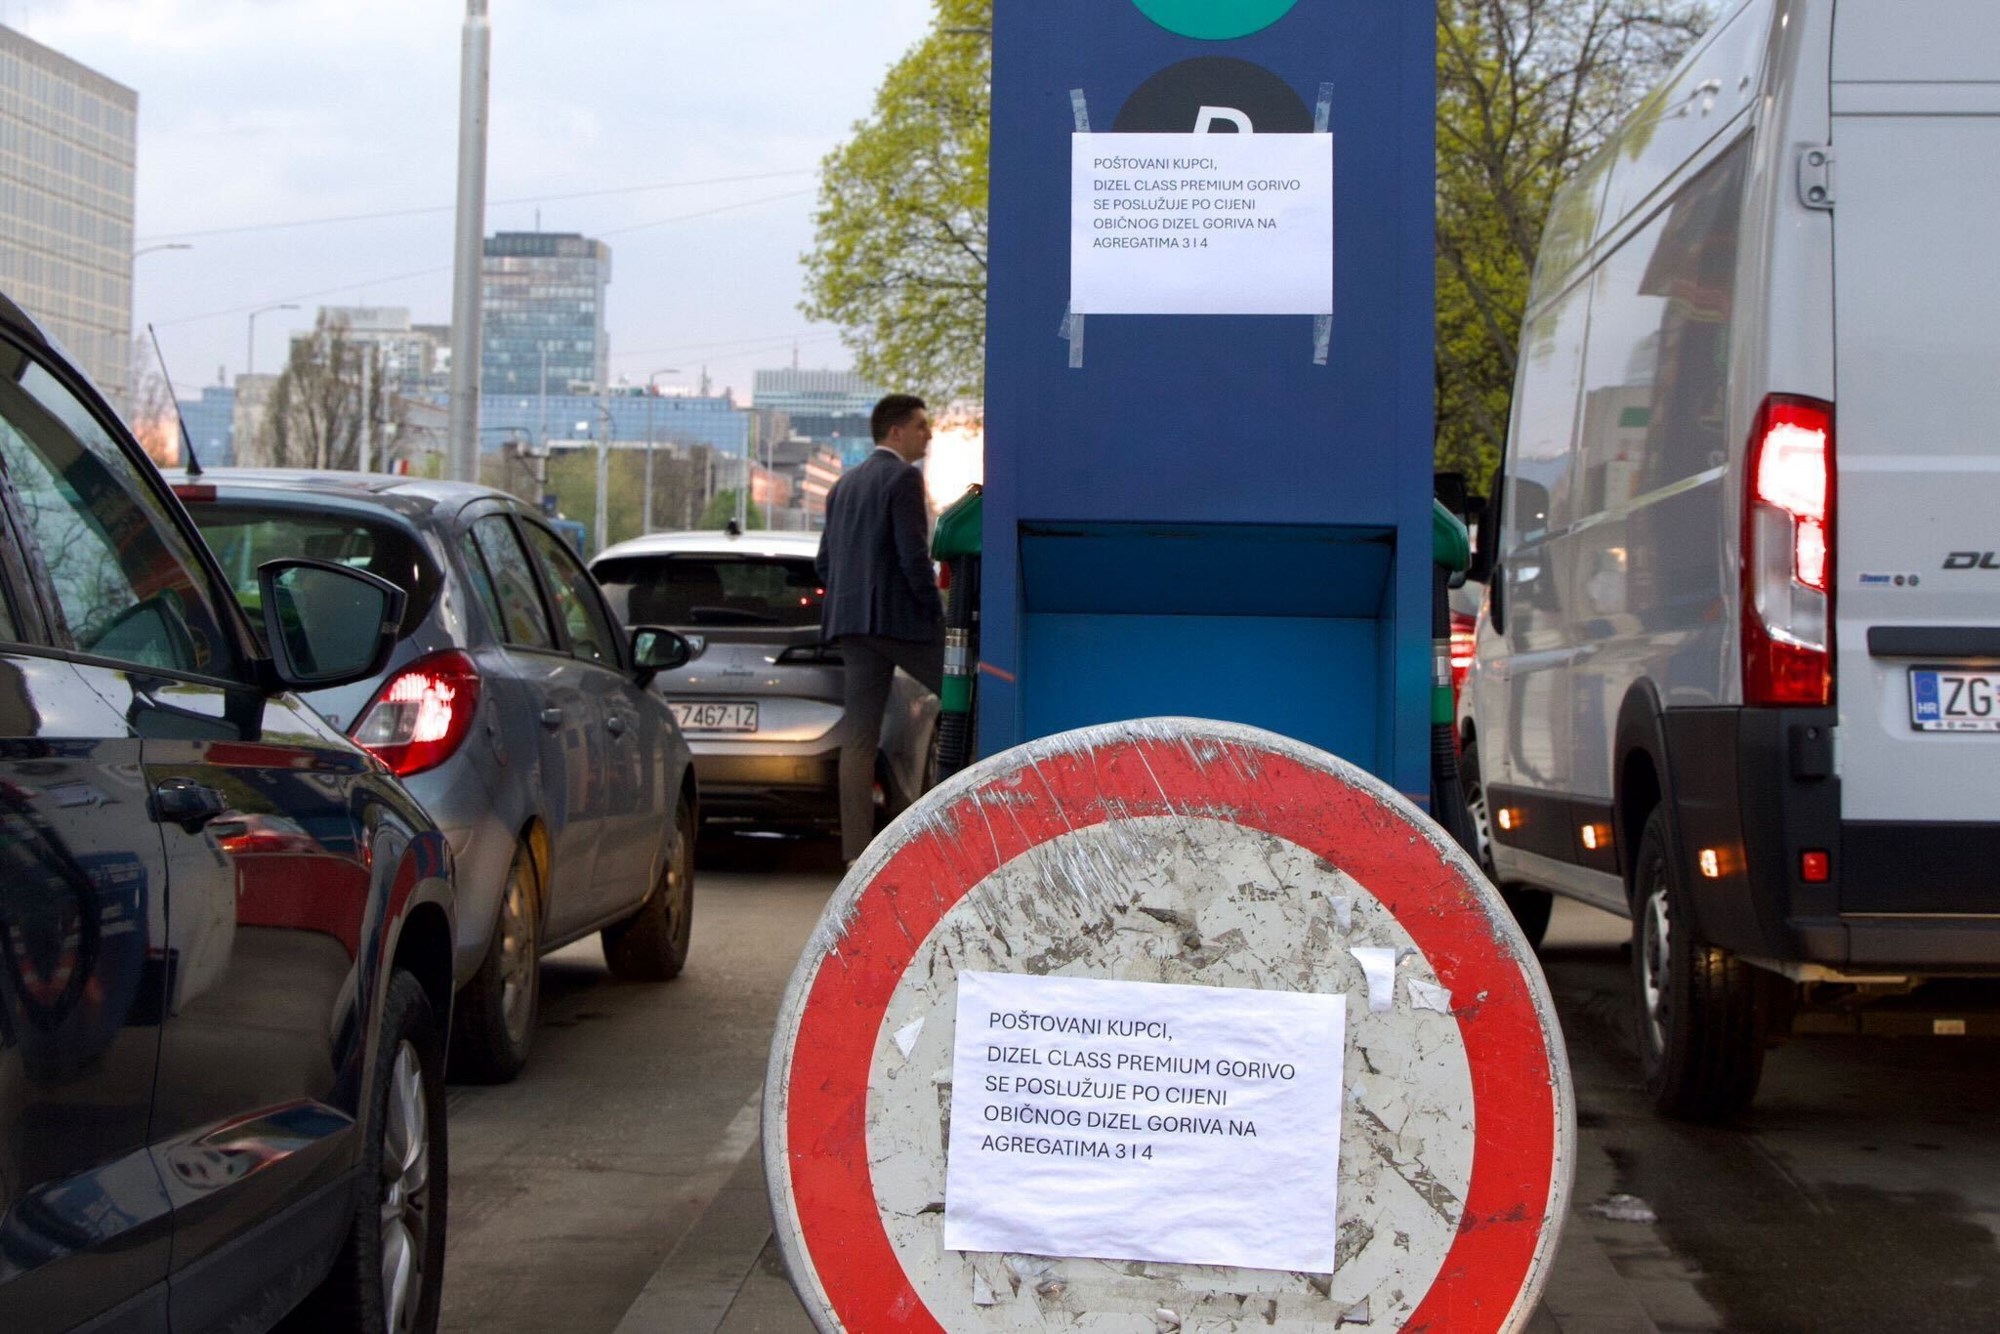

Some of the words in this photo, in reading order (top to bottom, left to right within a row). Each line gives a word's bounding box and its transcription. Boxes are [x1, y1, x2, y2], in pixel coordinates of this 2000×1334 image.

[1093, 155, 1170, 170] POŠTOVANI
[1173, 158, 1218, 172] KUPCI,
[1093, 179, 1132, 192] DIZEL
[1134, 179, 1178, 192] CLASS
[1180, 179, 1244, 191] PREMIUM
[1246, 179, 1301, 191] GORIVO
[1093, 198, 1110, 210] SE
[1113, 196, 1189, 210] POSLUŽUJE
[1191, 198, 1212, 210] PO
[1213, 198, 1256, 210] CIJENI
[1093, 215, 1160, 230] OBIČNOG
[1162, 217, 1200, 229] DIZEL
[1202, 217, 1255, 229] GORIVA
[1257, 217, 1277, 229] NA
[1092, 236, 1180, 249] AGREGATIMA
[1182, 237, 1190, 248] 3
[1193, 237, 1197, 248] I
[1199, 237, 1208, 248] 4
[1942, 677, 1992, 717] ZG
[1917, 702, 1938, 715] HR
[989, 1010, 1102, 1036] POŠTOVANI
[1107, 1018, 1173, 1042] KUPCI,
[987, 1045, 1043, 1066] DIZEL
[1047, 1049, 1112, 1070] CLASS
[1116, 1053, 1211, 1076] PREMIUM
[1215, 1059, 1296, 1081] GORIVO
[984, 1074, 1011, 1093] SE
[1014, 1076, 1128, 1100] POSLUŽUJE
[1132, 1084, 1161, 1103] PO
[1165, 1086, 1227, 1106] CIJENI
[983, 1103, 1082, 1127] OBIČNOG
[1087, 1111, 1143, 1131] DIZEL
[1146, 1114, 1224, 1136] GORIVA
[1228, 1119, 1257, 1138] NA
[981, 1134, 1111, 1159] AGREGATIMA
[1114, 1142, 1127, 1160] 3
[1131, 1143, 1137, 1160] I
[1140, 1143, 1153, 1161] 4
